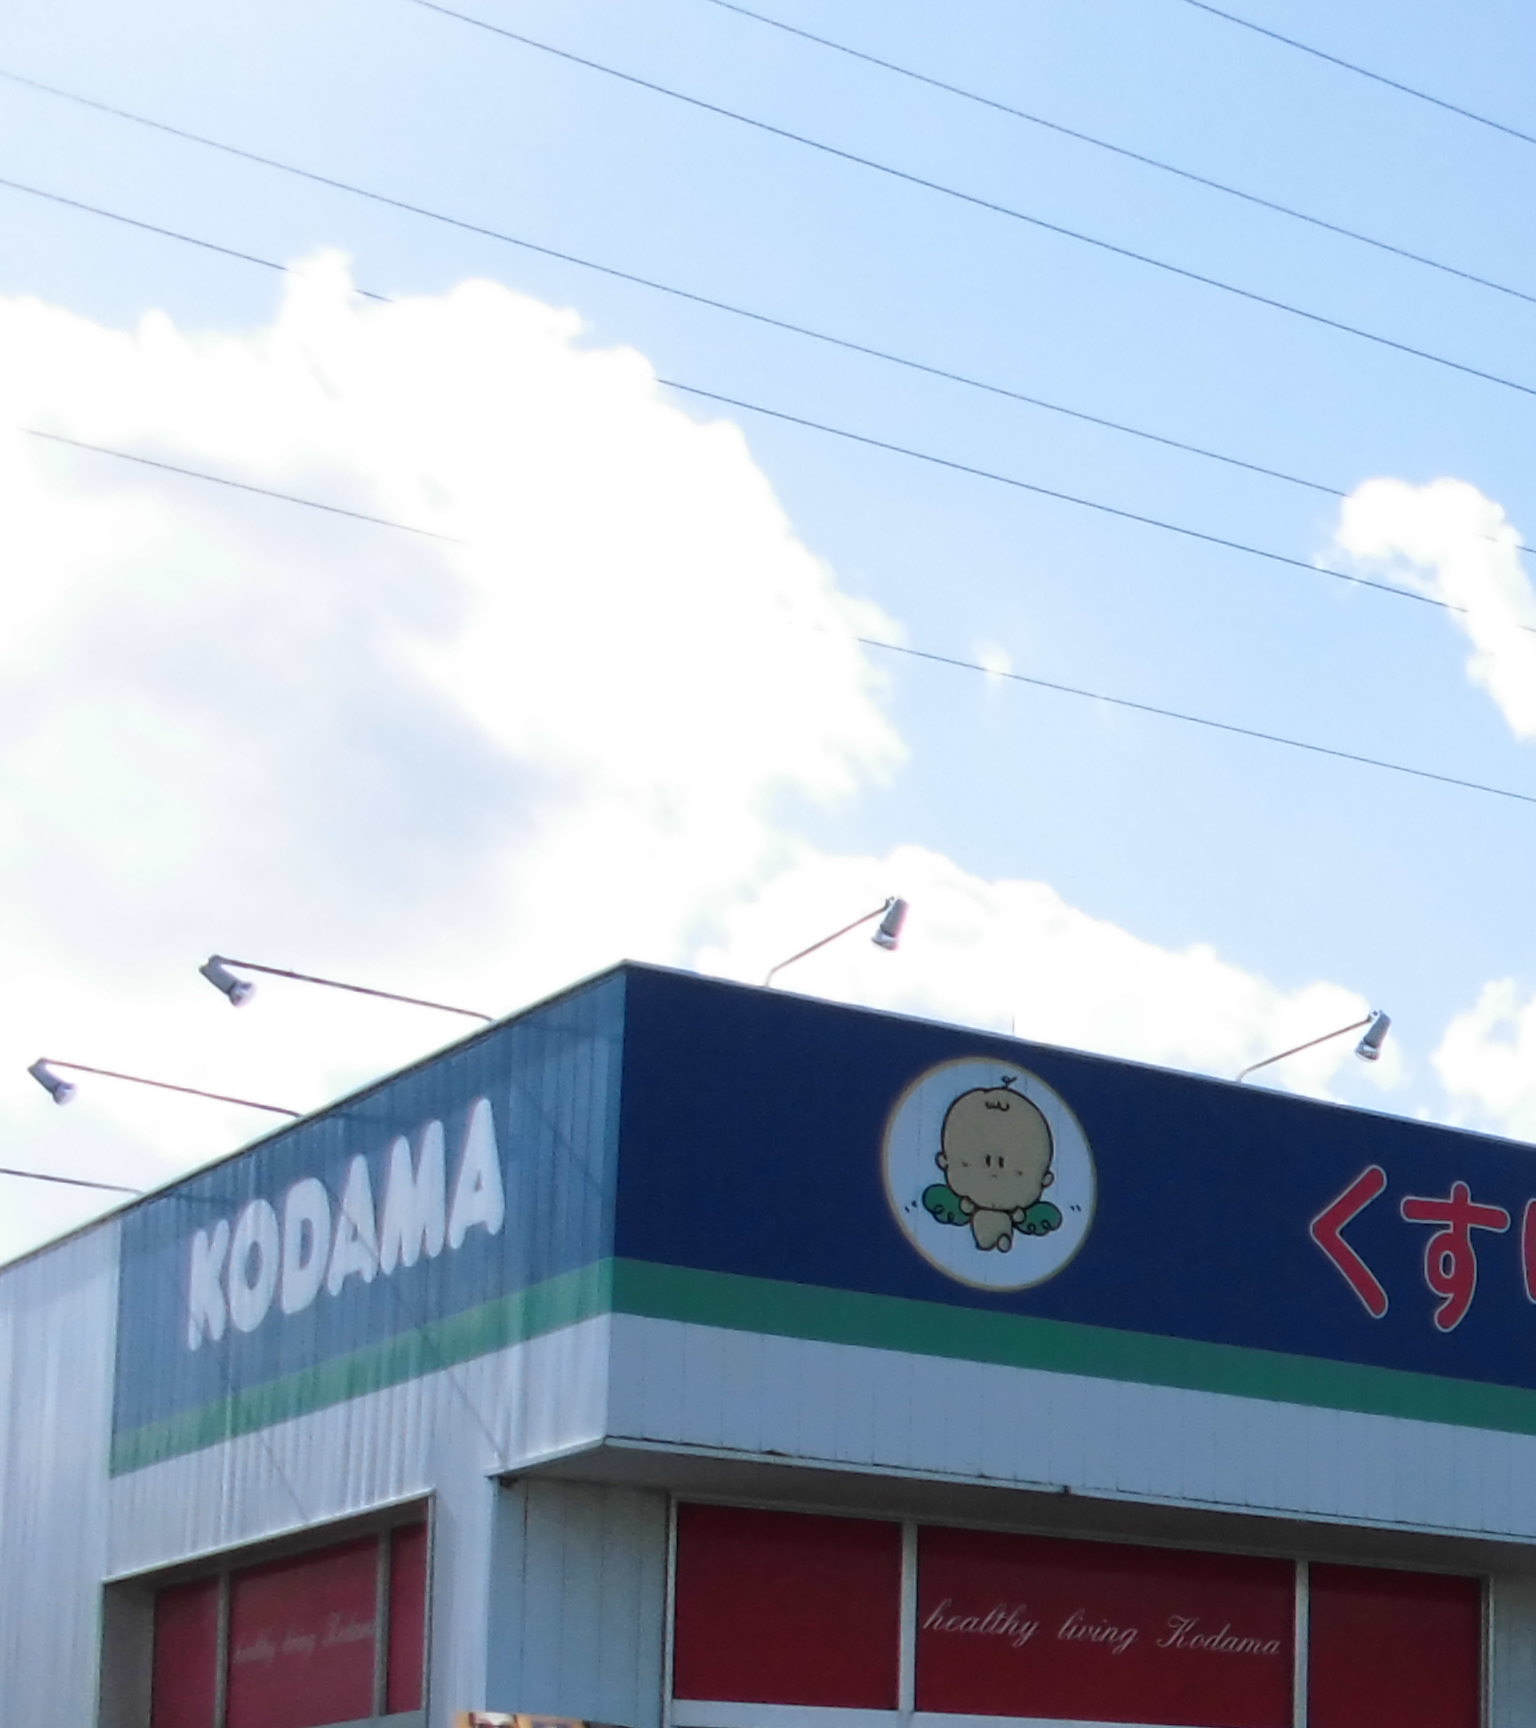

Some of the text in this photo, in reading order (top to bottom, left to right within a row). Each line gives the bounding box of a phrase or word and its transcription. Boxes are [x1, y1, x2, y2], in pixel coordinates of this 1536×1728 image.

[187, 1097, 505, 1351] KODAMA
[922, 1597, 1281, 1655] healthy living Kodama
